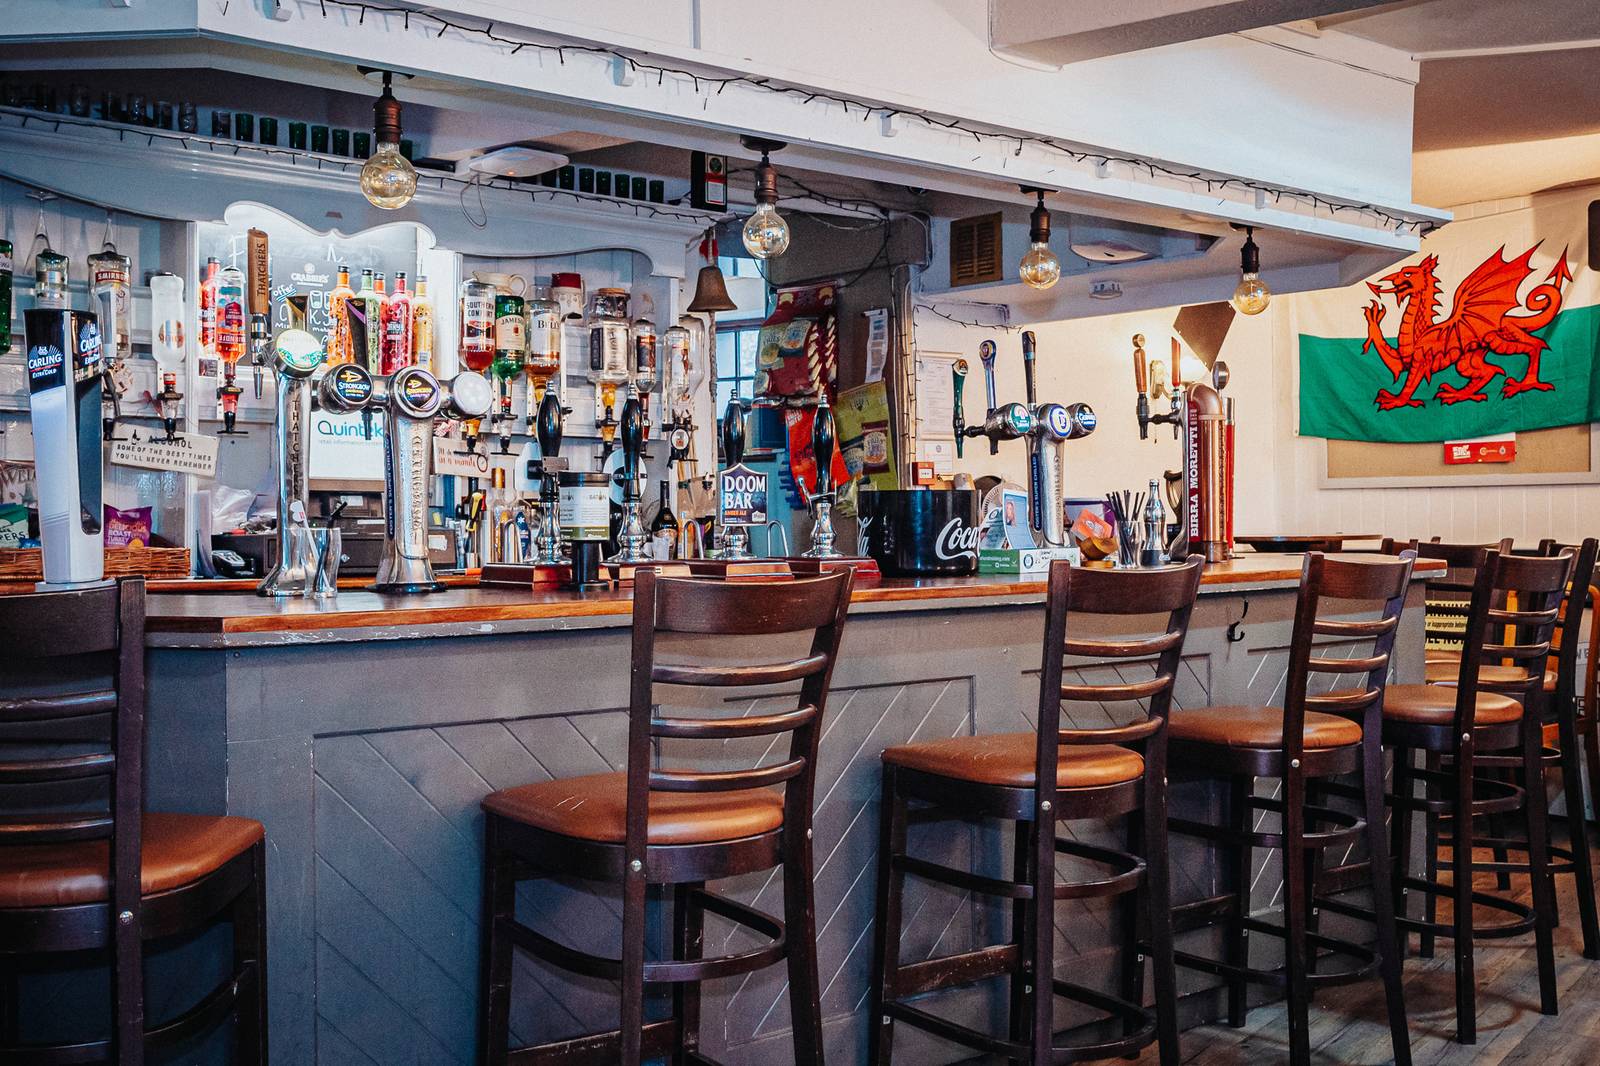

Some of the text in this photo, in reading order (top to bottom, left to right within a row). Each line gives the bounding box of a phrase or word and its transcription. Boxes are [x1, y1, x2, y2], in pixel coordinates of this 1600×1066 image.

[257, 243, 265, 296] THATCHERS
[468, 310, 493, 318] COMRT
[29, 354, 63, 370] CARLING
[338, 382, 371, 391] STRONGBOW
[318, 421, 383, 437] Quintk
[117, 444, 135, 452] SOME
[166, 450, 185, 458] BEST
[188, 453, 211, 461] TIMES
[1190, 427, 1199, 489] MORETTI
[146, 456, 170, 464] NEVER
[174, 461, 212, 470] REMEMBER
[725, 475, 765, 493] DOOM
[725, 492, 753, 509] BAR
[1190, 494, 1199, 536] BIRRA
